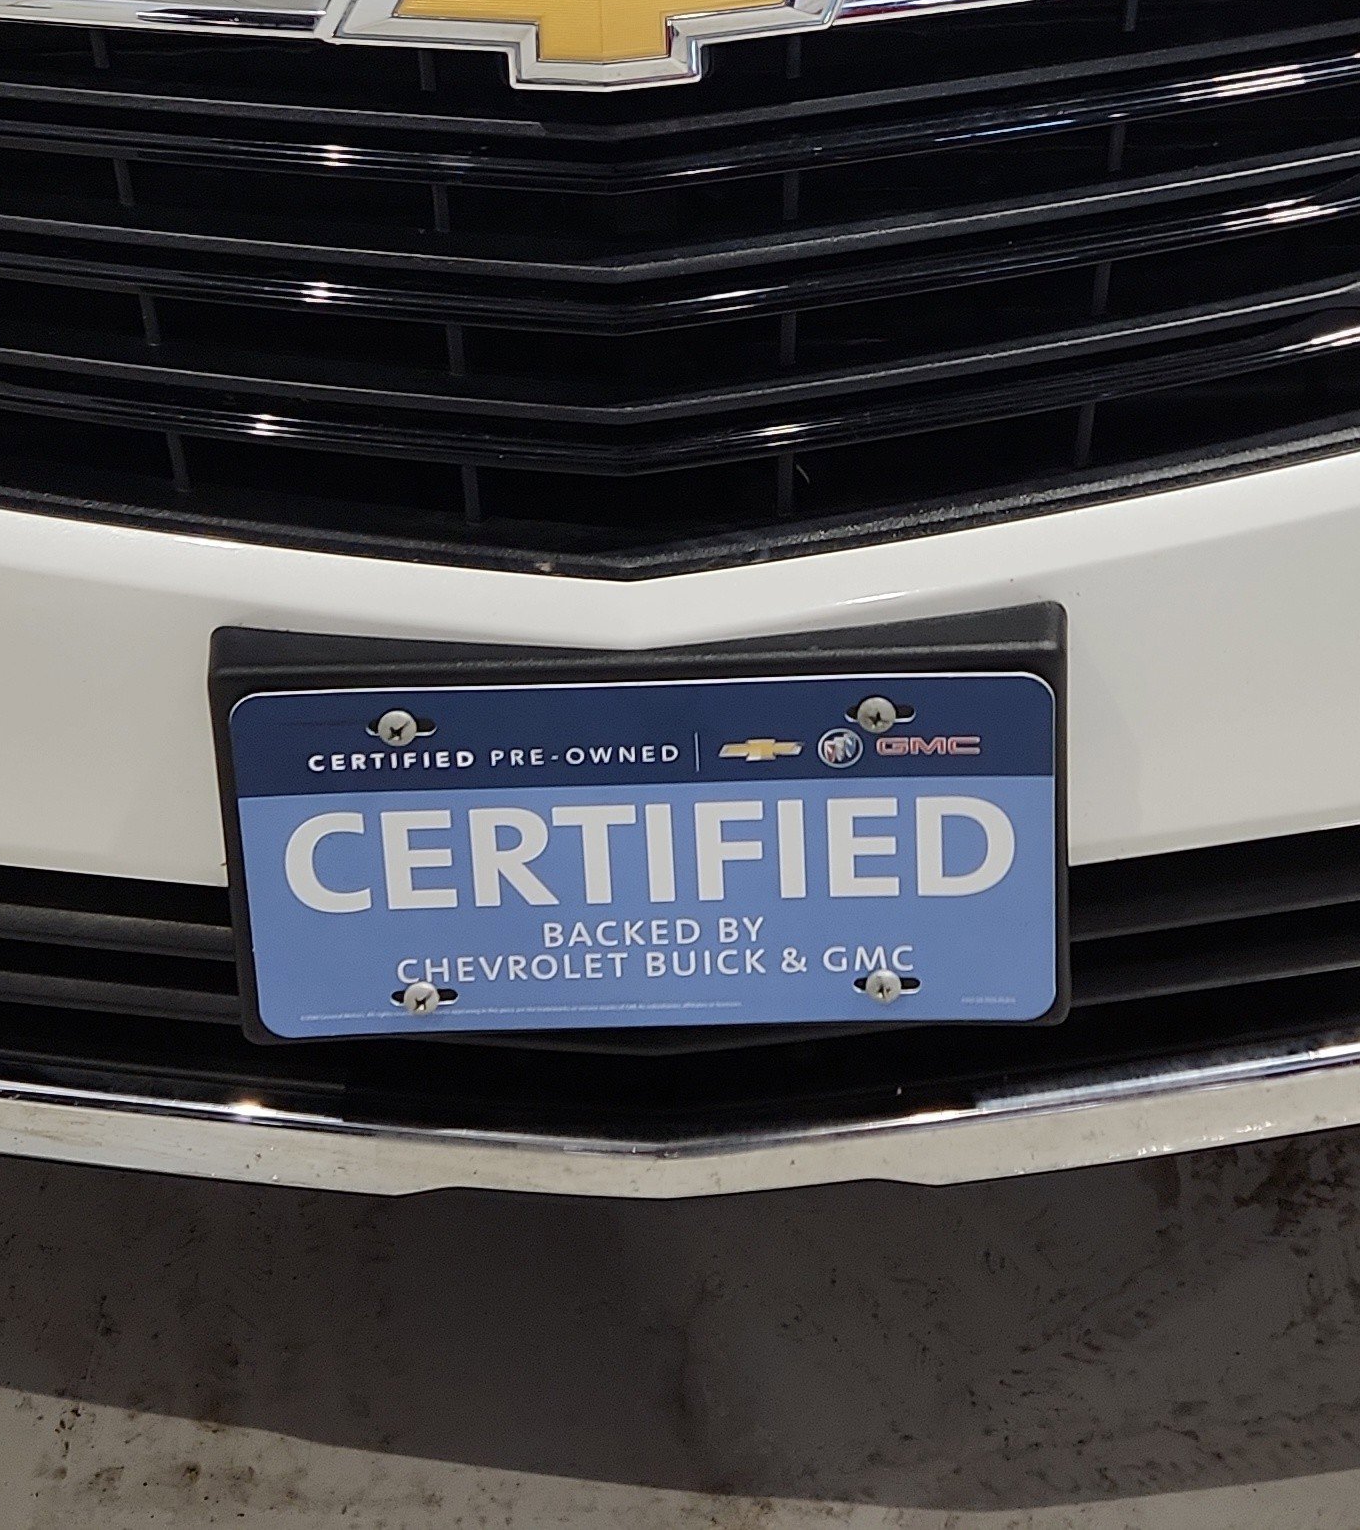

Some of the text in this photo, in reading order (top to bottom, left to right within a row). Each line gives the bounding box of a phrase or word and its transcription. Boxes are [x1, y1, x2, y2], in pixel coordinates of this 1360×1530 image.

[307, 743, 679, 771] CERTIFIED PRE-OWNED
[876, 735, 981, 756] GMC
[283, 796, 1015, 914] CERTIFIED
[543, 916, 764, 948] BACKED BY
[396, 945, 914, 984] CHEVROLET BUICK & GMC
